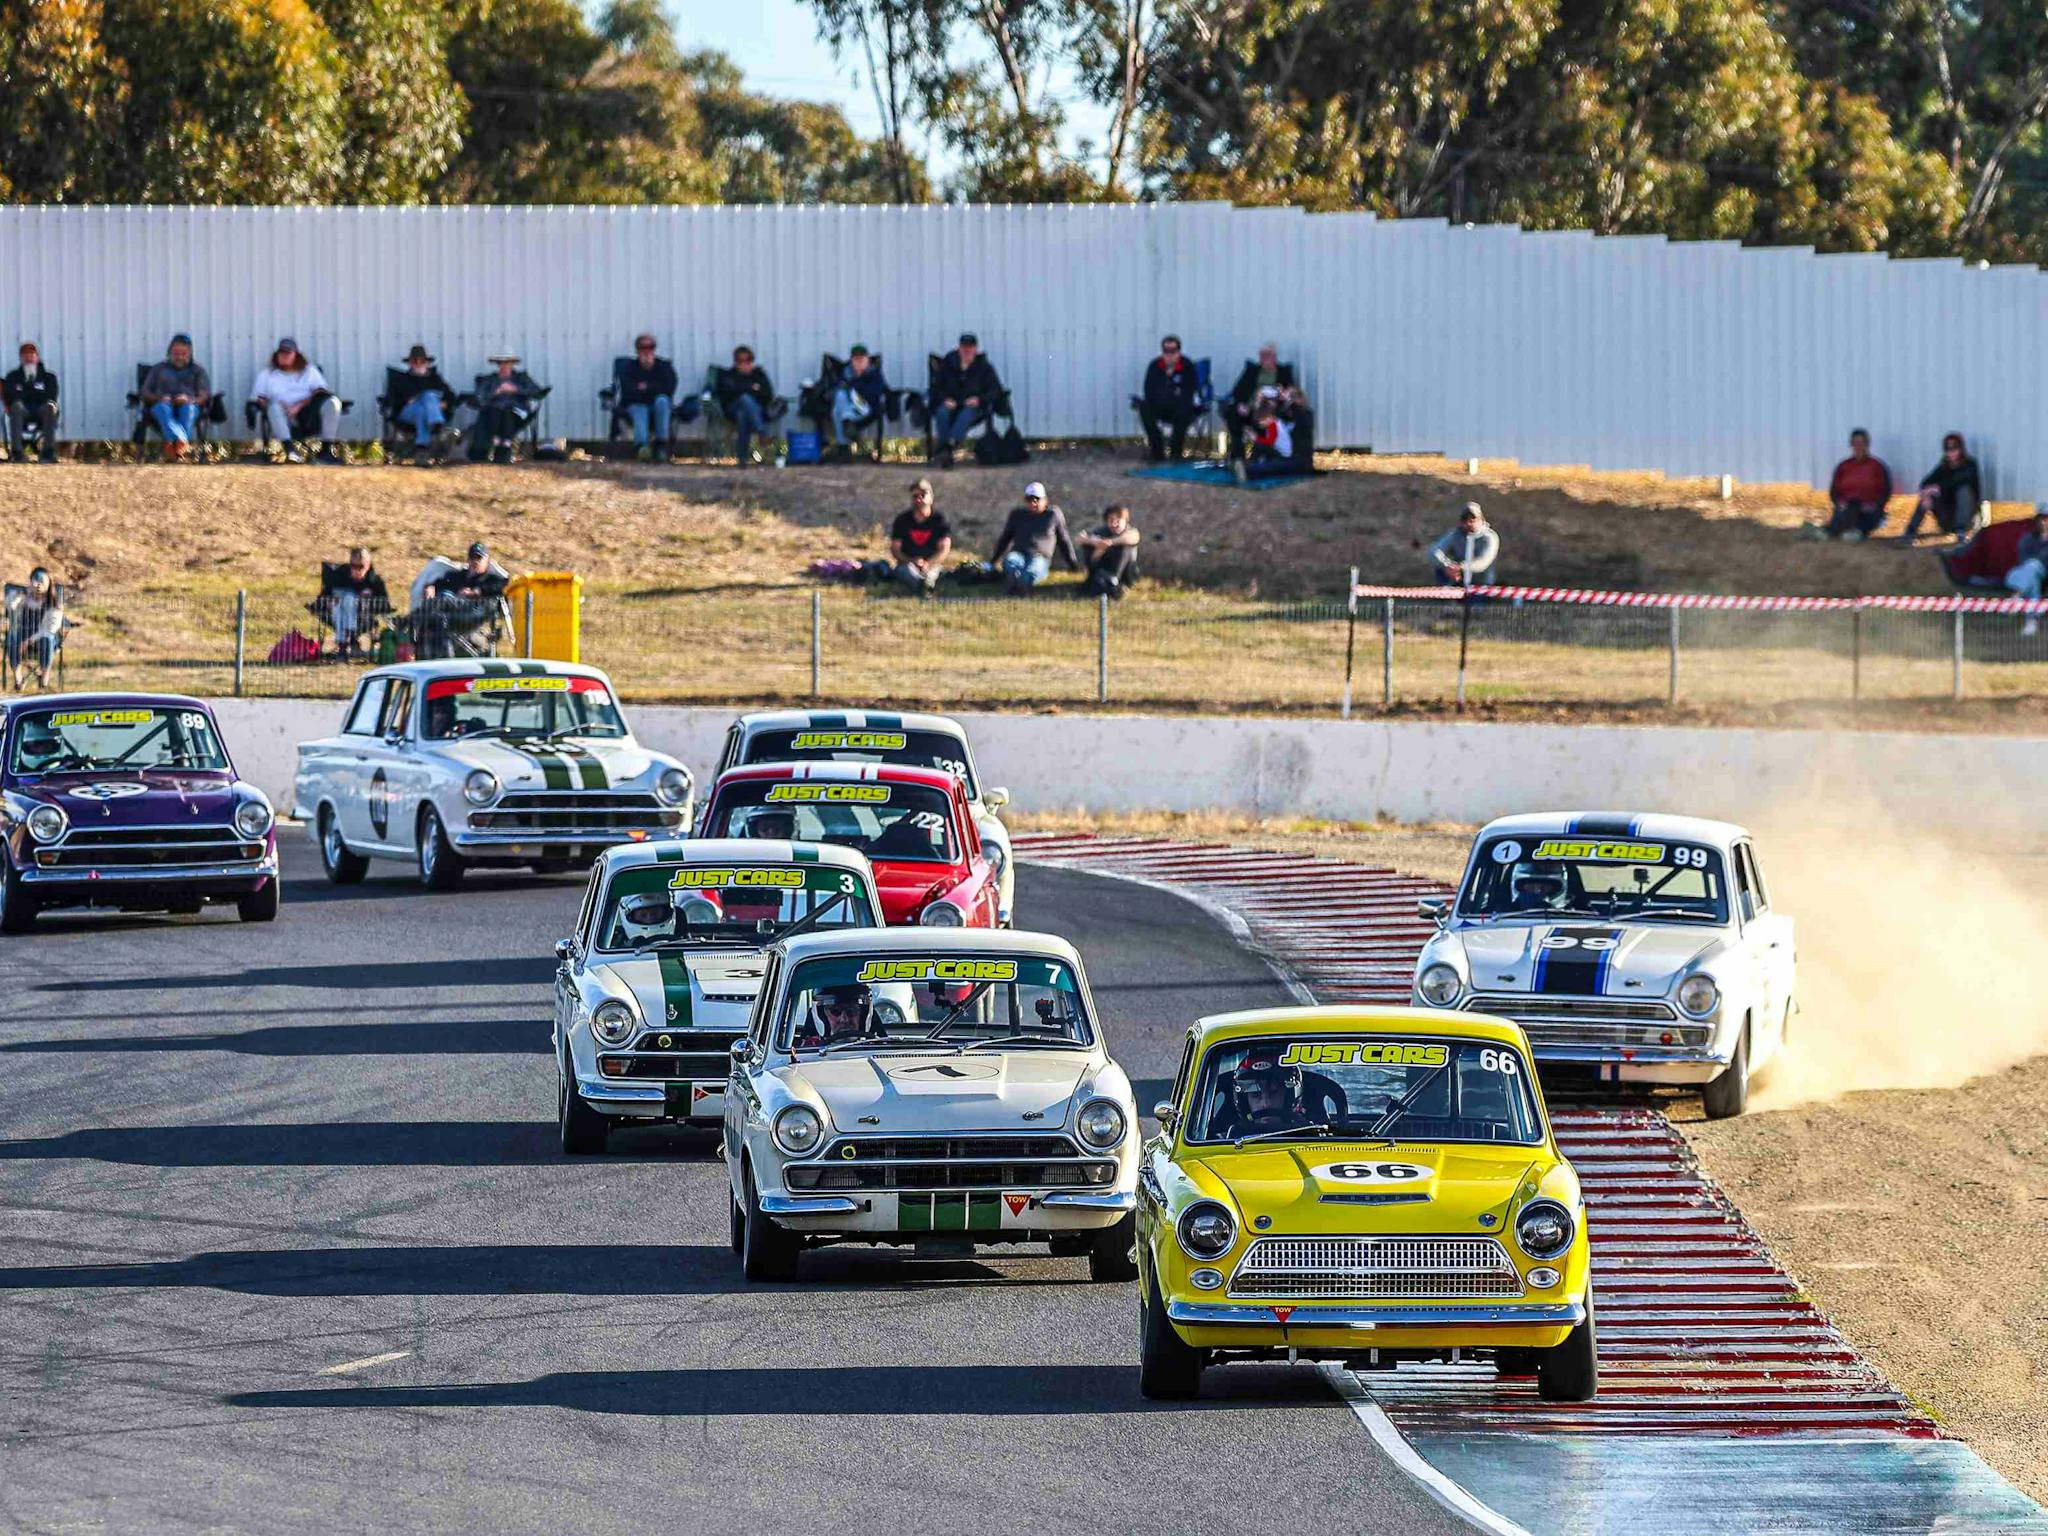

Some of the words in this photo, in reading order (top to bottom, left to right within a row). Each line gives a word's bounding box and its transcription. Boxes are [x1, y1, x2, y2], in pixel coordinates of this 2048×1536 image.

[474, 679, 515, 690] JUST
[519, 679, 566, 690] CARS
[53, 712, 97, 726] JUST
[100, 711, 152, 723] CARS
[181, 713, 205, 730] 89
[794, 734, 847, 747] JUST
[847, 734, 904, 748] CARS
[768, 785, 826, 800] JUST
[826, 785, 889, 801] CARS
[916, 811, 945, 832] 22
[1502, 845, 1510, 859] 1
[1536, 842, 1597, 857] JUST
[1597, 844, 1663, 860] CARS
[1674, 847, 1708, 868] 99
[671, 870, 734, 887] JUST
[734, 870, 804, 886] CARS
[839, 874, 855, 894] 3
[1542, 936, 1619, 950] 99
[859, 961, 934, 980] JUST
[935, 961, 1016, 980] CARS
[1045, 964, 1062, 984] 7
[1280, 1044, 1360, 1064] JUST
[1360, 1044, 1447, 1065] CARS
[1479, 1049, 1516, 1075] 66
[901, 1065, 970, 1078] 7
[1329, 1164, 1419, 1179] 66
